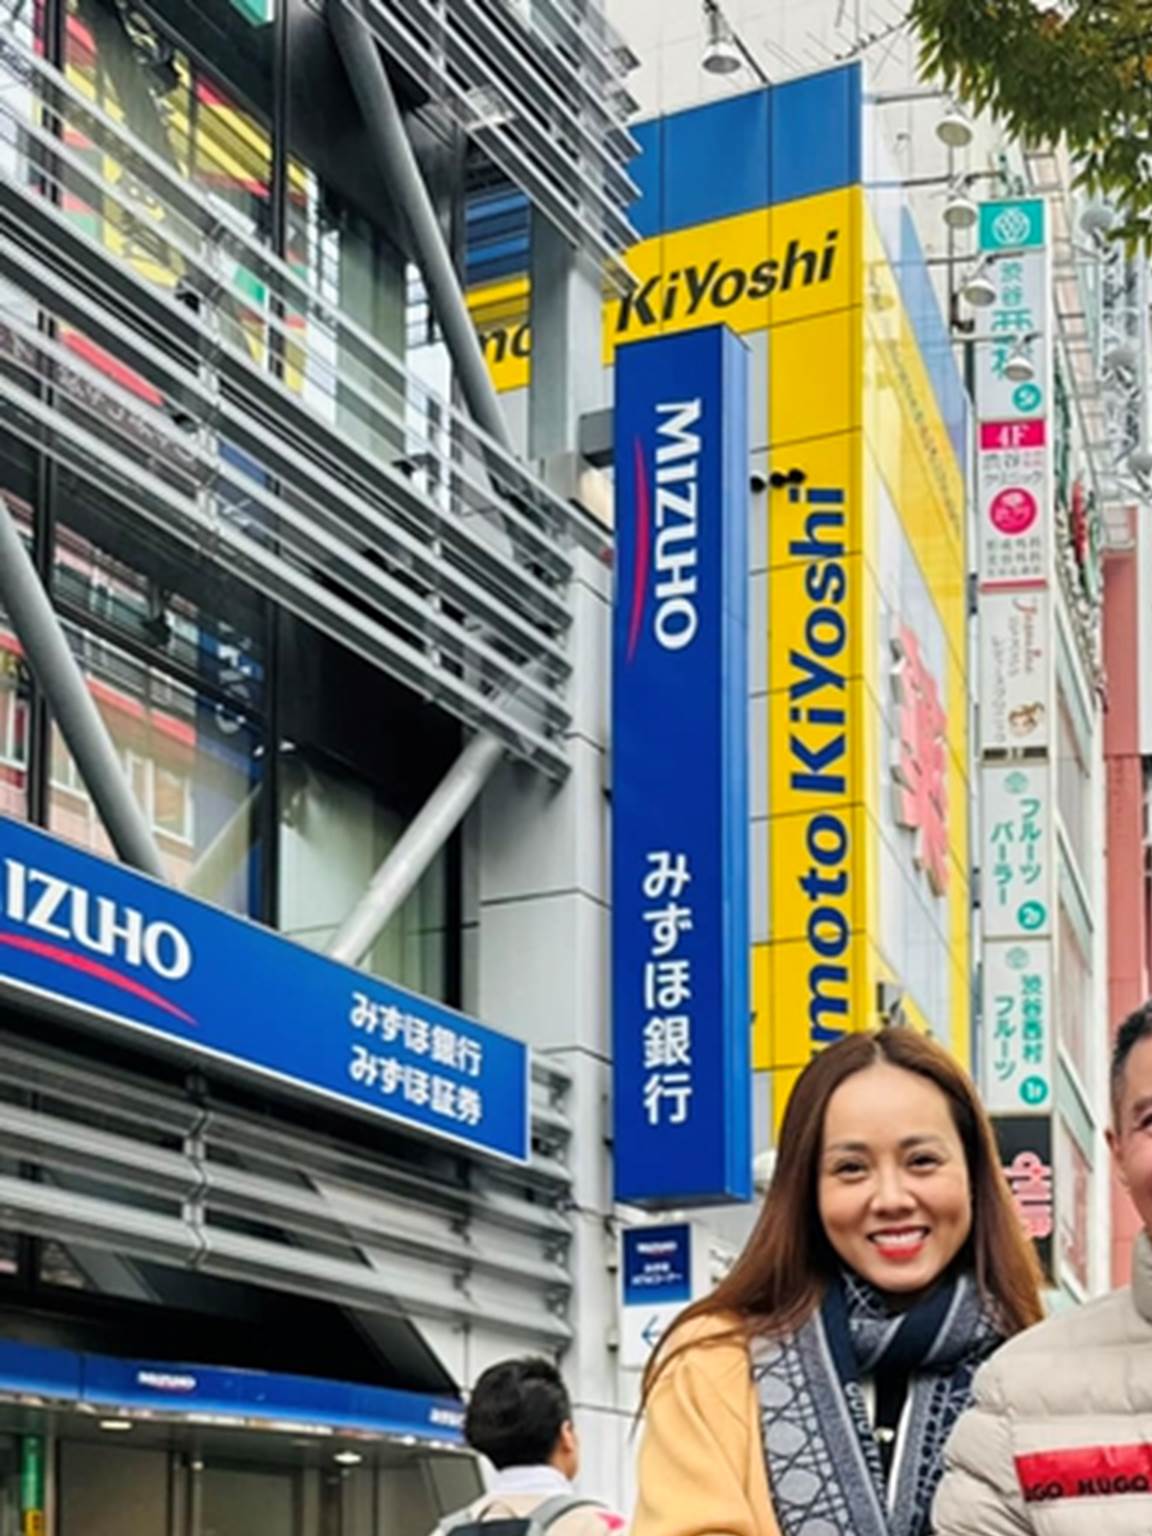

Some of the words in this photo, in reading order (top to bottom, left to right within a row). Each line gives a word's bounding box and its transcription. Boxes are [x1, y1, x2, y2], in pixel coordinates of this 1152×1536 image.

[615, 229, 840, 334] KiYoshi
[653, 398, 702, 651] MIZUHO
[788, 487, 848, 795] KiYoshi
[3, 857, 192, 980] IZUHO
[798, 813, 849, 1055] moto
[349, 990, 483, 1078] みずほ銀行
[642, 851, 693, 1125] みずほ銀行
[349, 1043, 483, 1127] みずほ証券
[1077, 1473, 1149, 1496] HUGO
